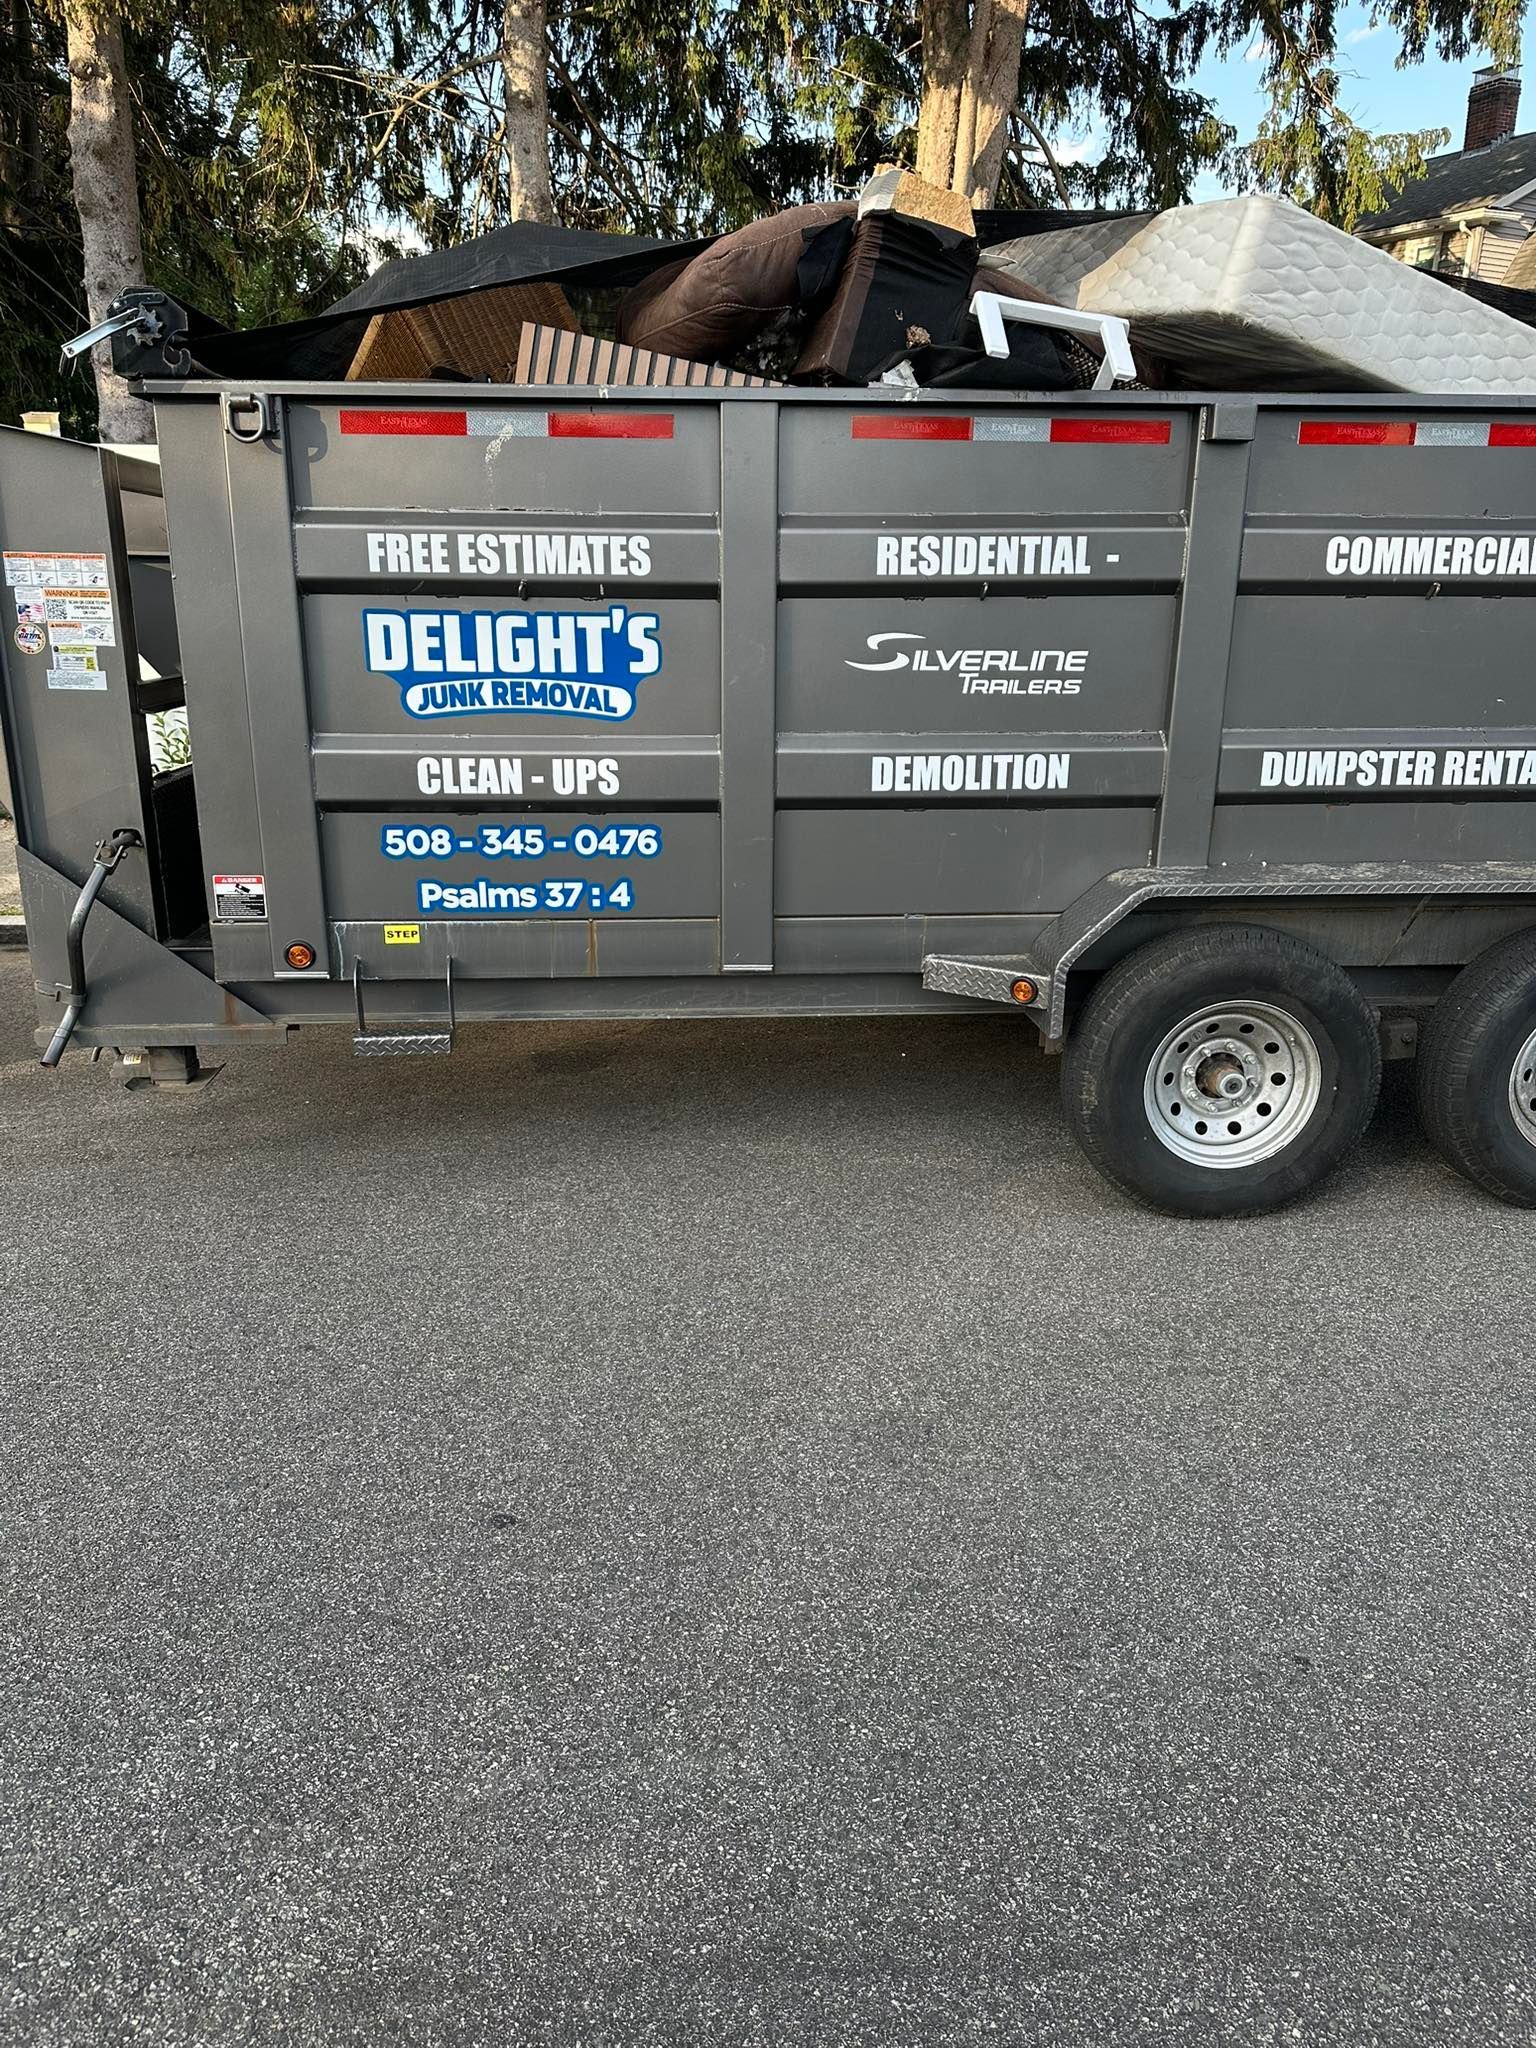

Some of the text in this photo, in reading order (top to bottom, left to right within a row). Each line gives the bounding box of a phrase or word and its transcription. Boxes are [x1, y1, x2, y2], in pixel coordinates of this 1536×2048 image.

[366, 533, 651, 576] FREE ESTIMATES
[876, 535, 1120, 576] RESIDENTIAL -
[366, 608, 660, 674] DELIGHT'S
[418, 680, 618, 714] JUNK REMOVAL
[416, 757, 523, 795] CLEAN
[552, 758, 620, 795] UPS
[871, 753, 1071, 791] DEMOLITION
[1260, 750, 1436, 787] DUMPSTER
[385, 829, 452, 856] 508
[482, 829, 544, 855] 345
[574, 829, 658, 855] 0476
[421, 882, 537, 909] Psalms
[545, 882, 583, 908] 37
[609, 882, 631, 907] 4
[386, 930, 418, 939] STEP
